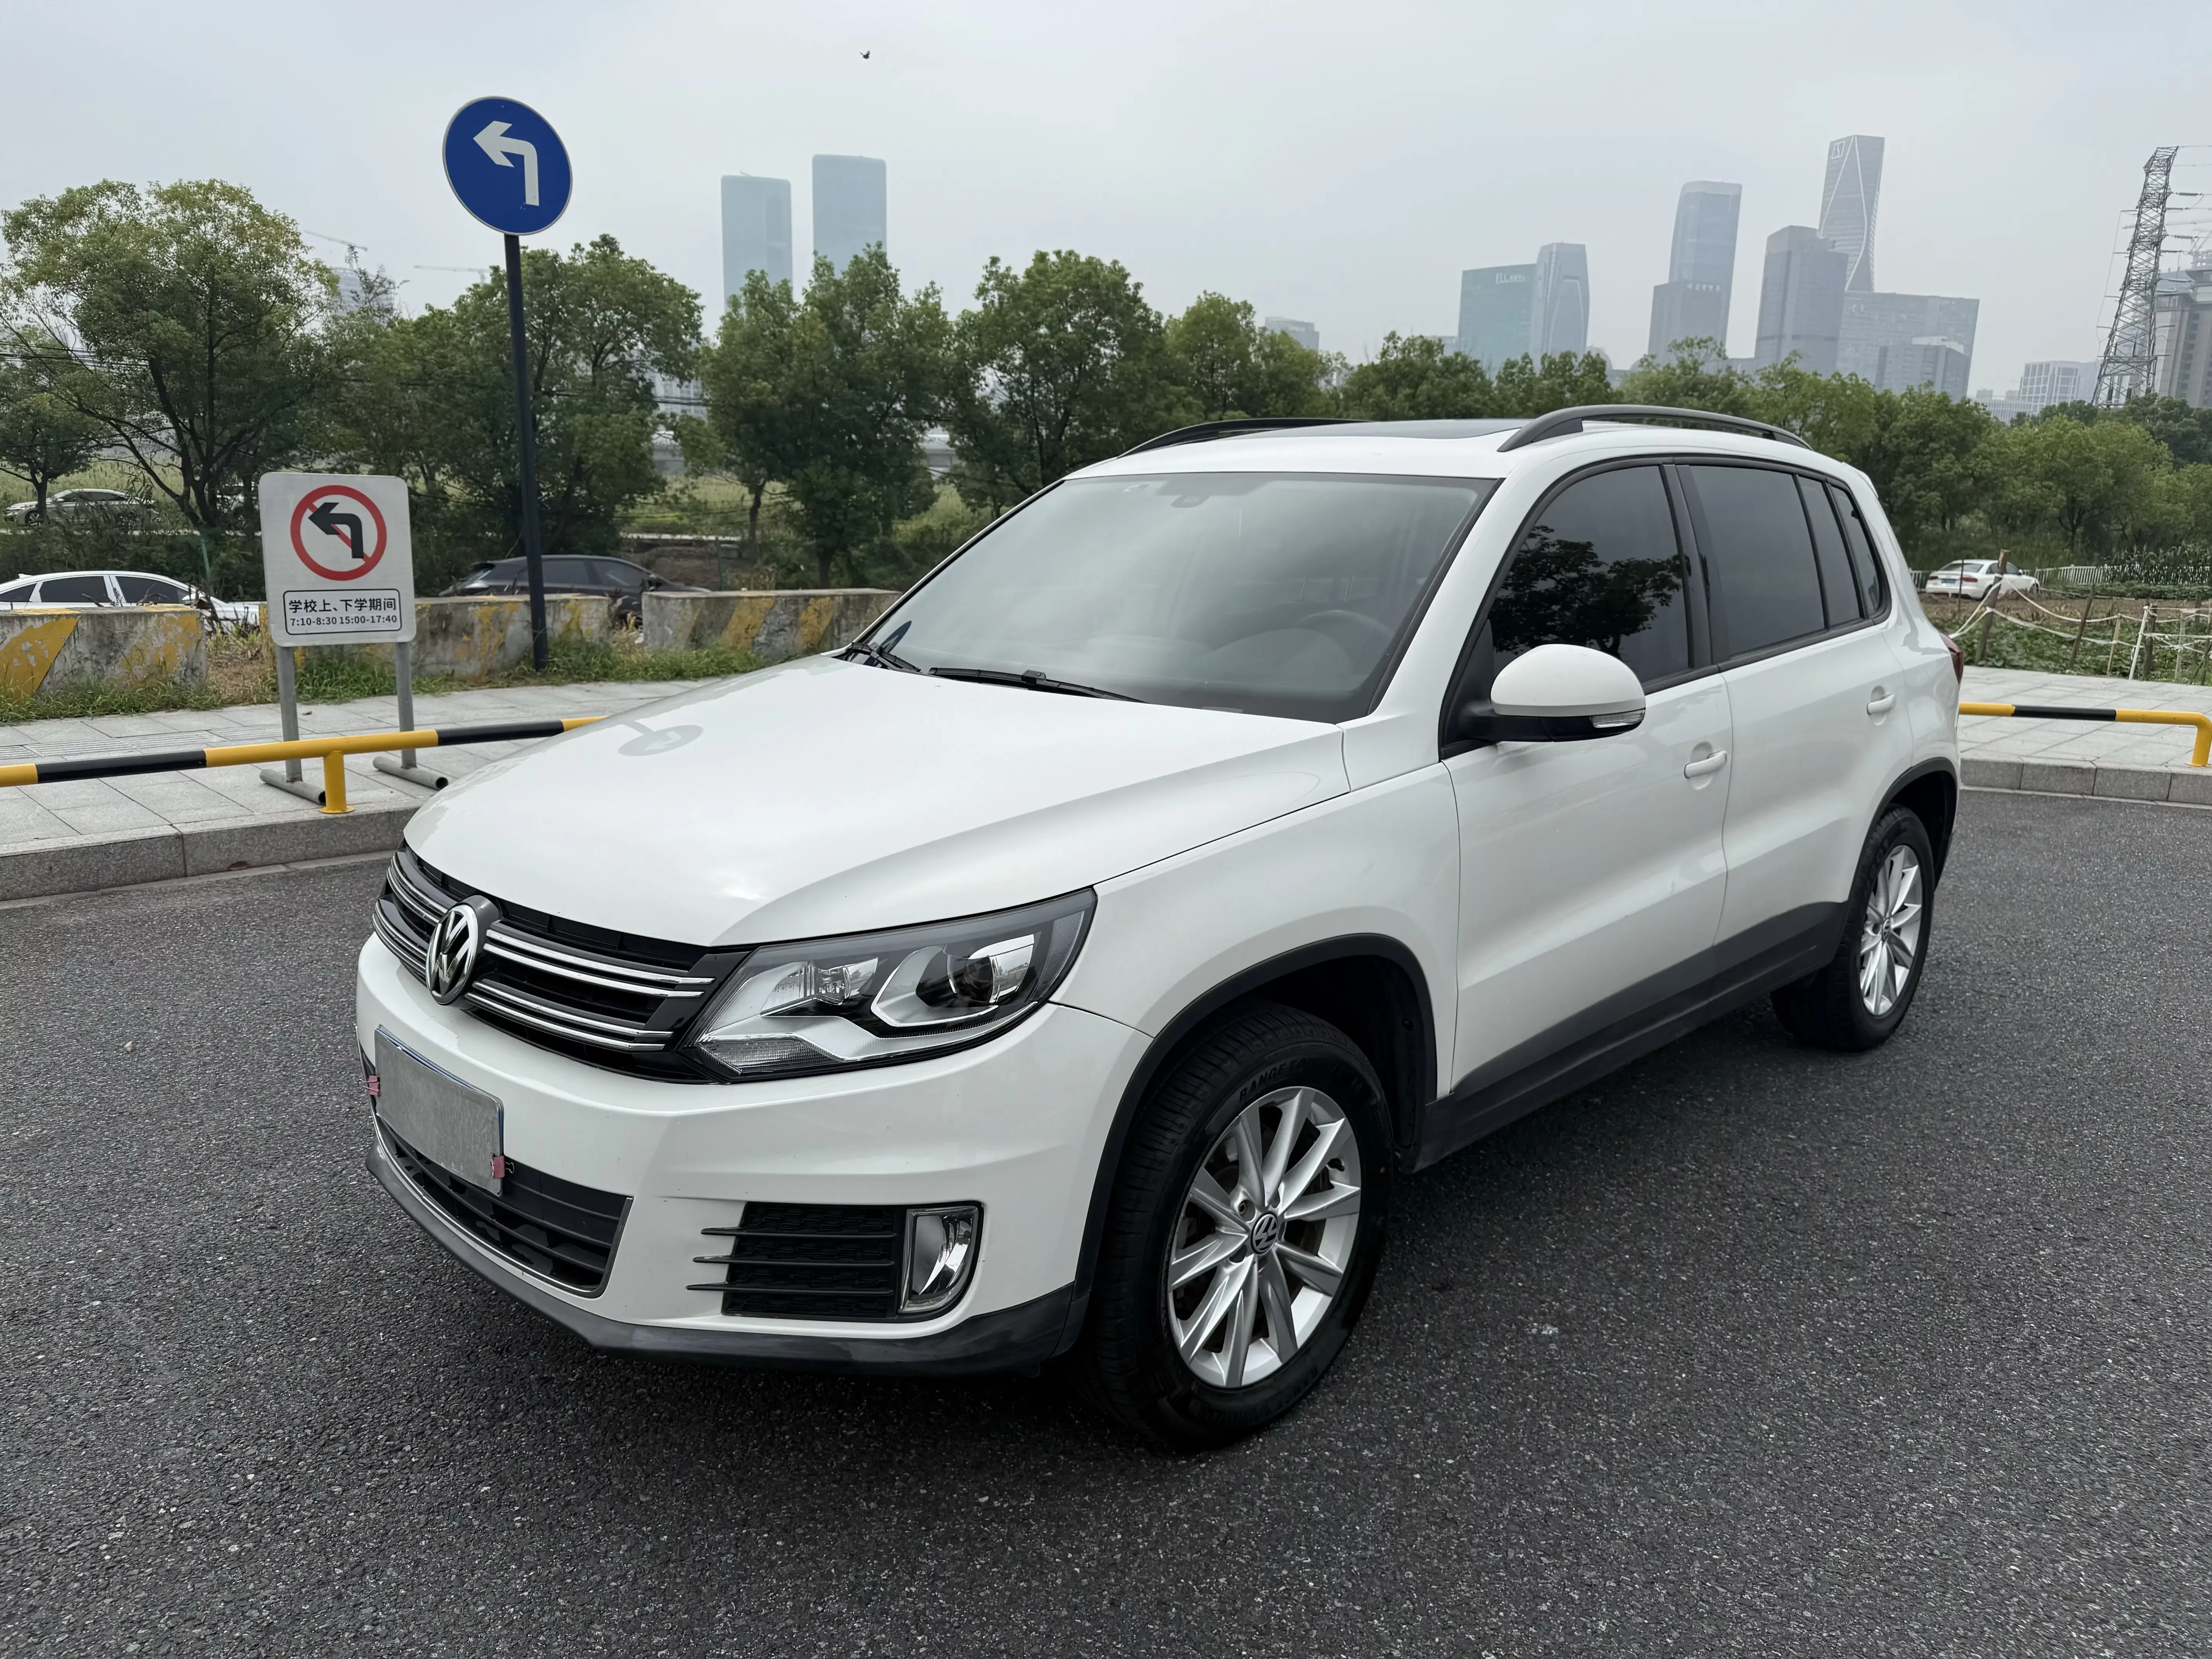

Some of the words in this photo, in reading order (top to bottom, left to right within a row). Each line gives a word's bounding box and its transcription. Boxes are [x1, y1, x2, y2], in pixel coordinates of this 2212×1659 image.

[289, 598, 396, 613] 学校上、下学期间
[290, 617, 337, 626] 7:10-8:30
[339, 615, 397, 624] 15:00-17:40
[1240, 1063, 1286, 1101] RANGE
